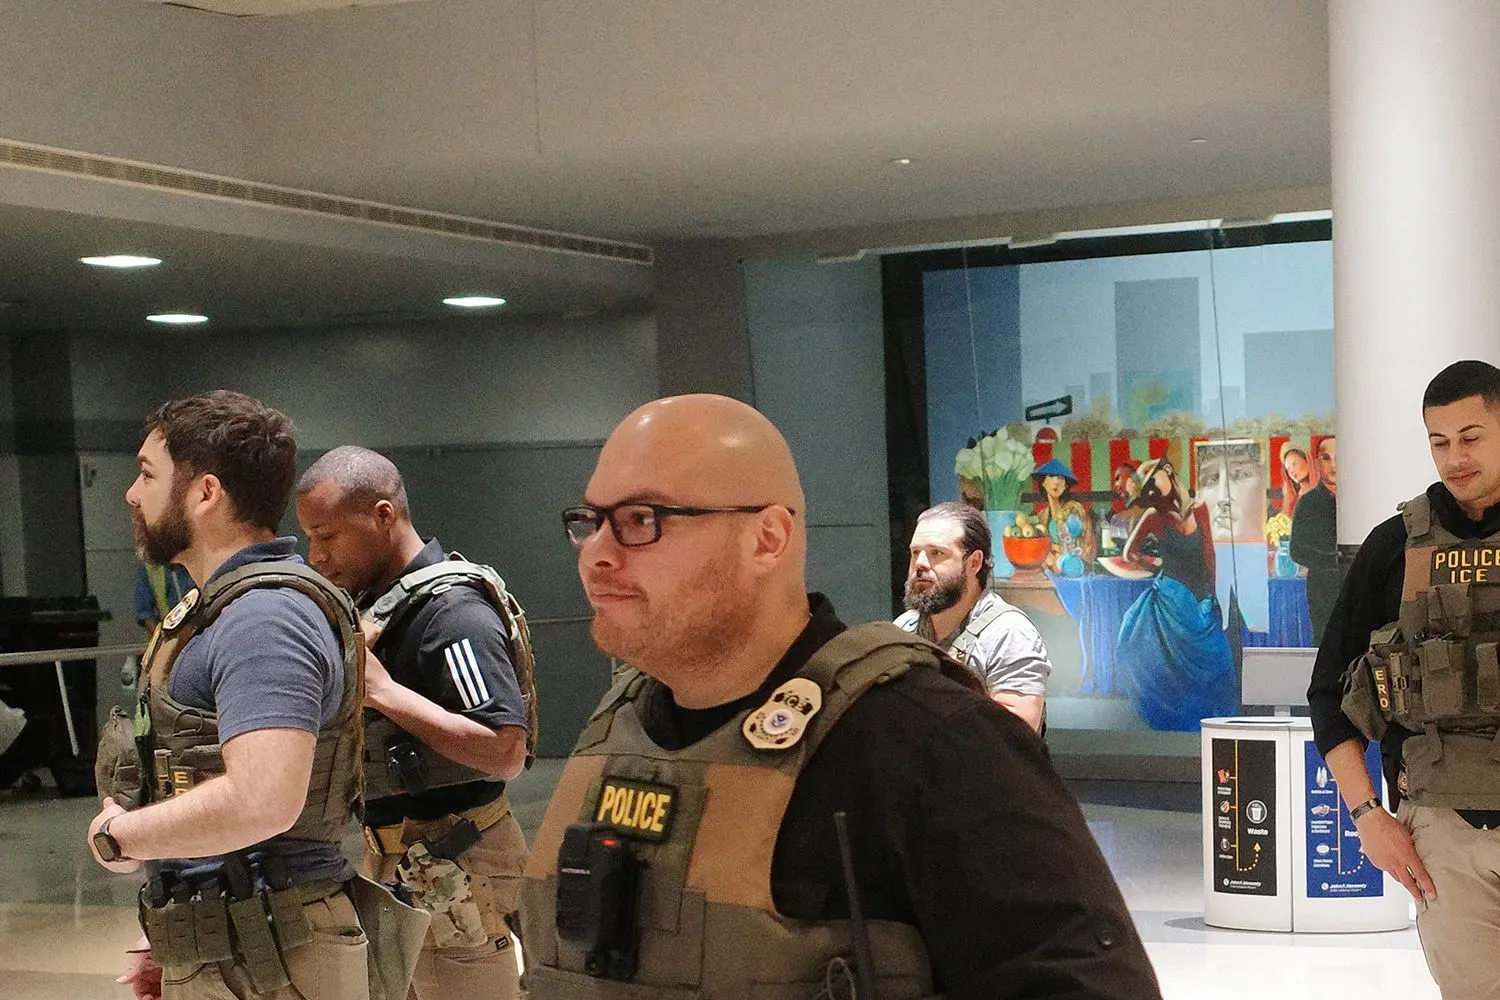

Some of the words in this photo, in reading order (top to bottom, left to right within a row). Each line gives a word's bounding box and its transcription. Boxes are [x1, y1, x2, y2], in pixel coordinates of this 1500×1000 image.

[1451, 568, 1488, 583] ICE
[1375, 670, 1388, 708] ERO
[597, 785, 672, 833] POLICE
[1247, 827, 1269, 836] Waste
